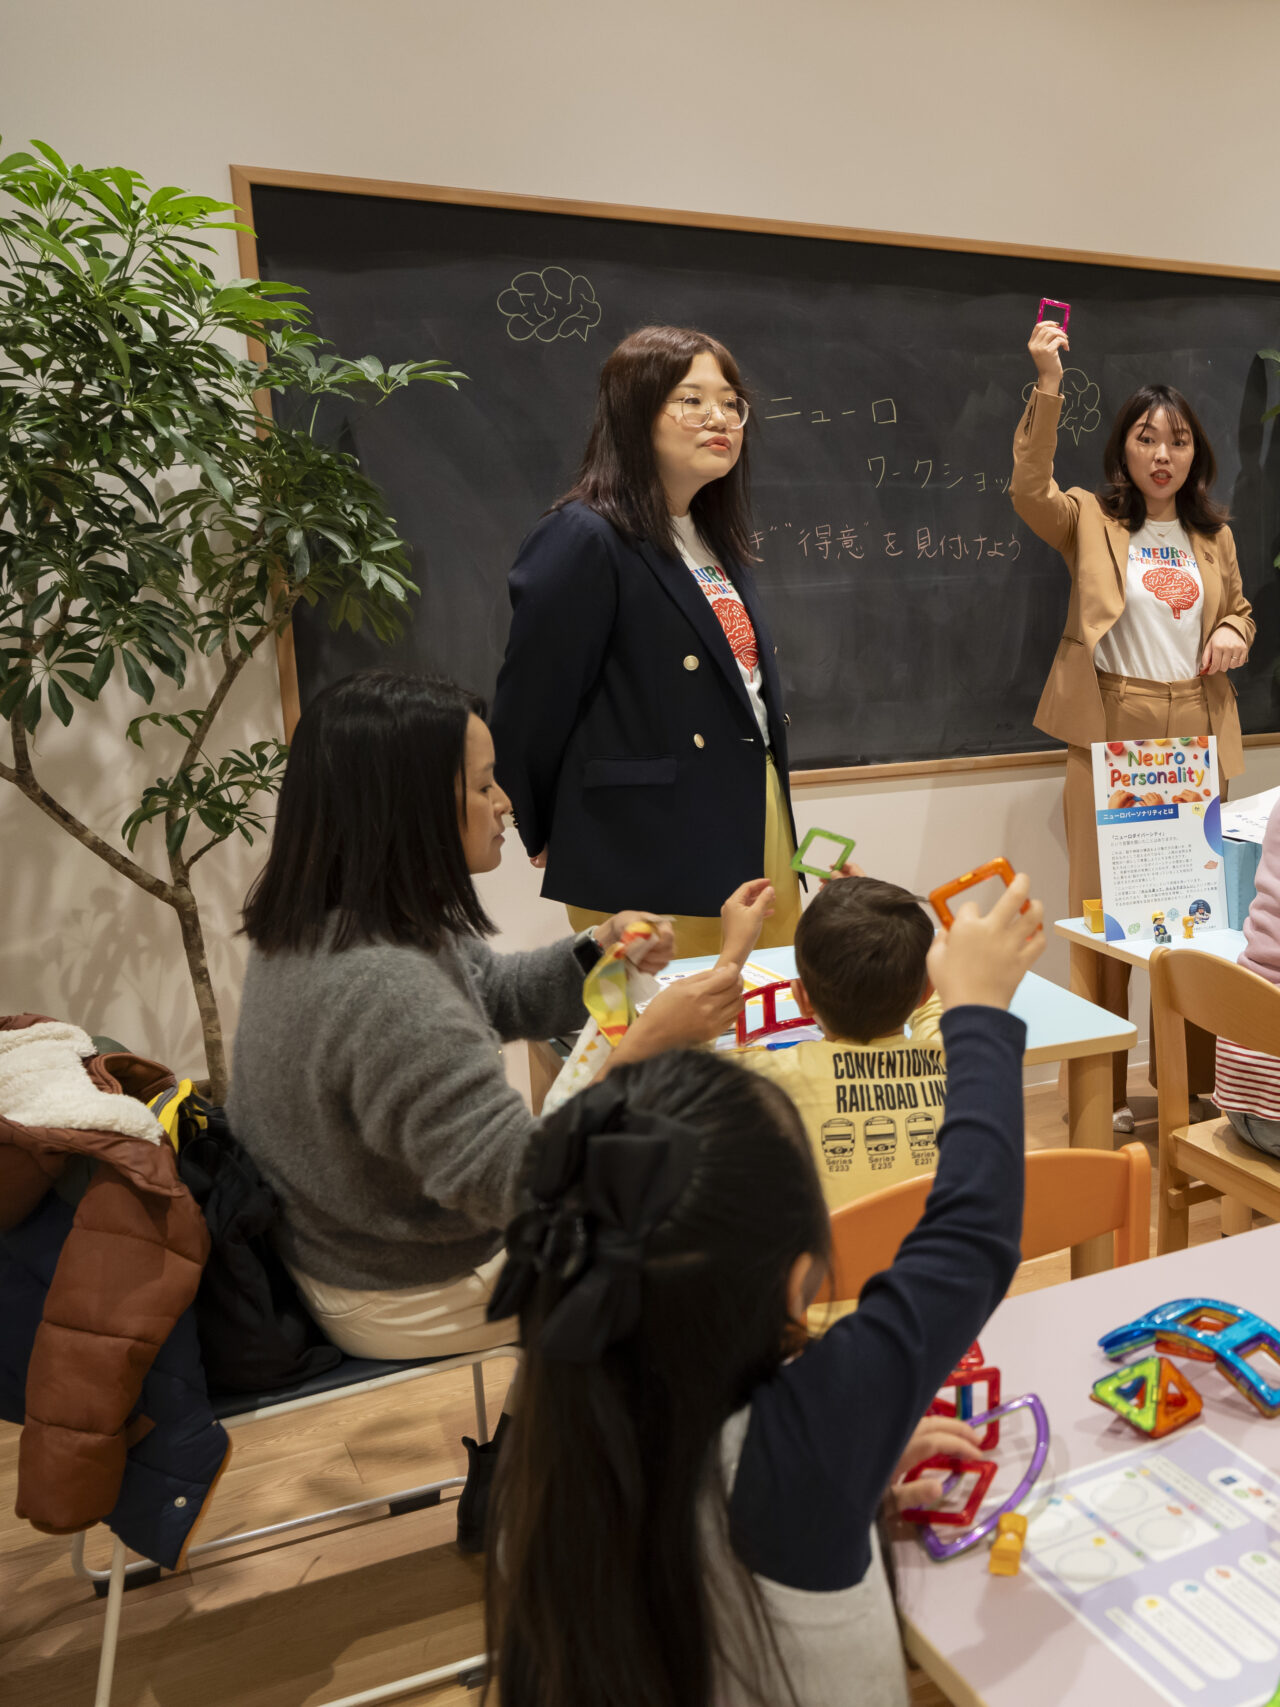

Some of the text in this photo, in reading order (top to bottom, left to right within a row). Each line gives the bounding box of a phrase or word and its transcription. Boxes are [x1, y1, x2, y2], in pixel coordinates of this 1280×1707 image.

[764, 396, 897, 425] ニューロ
[1141, 546, 1188, 560] NEURO
[1127, 749, 1185, 767] Neuro
[1110, 766, 1205, 788] Personality
[1103, 807, 1174, 820] ニューロパーソナリティとは
[833, 1048, 947, 1080] CONVENTIONAL
[836, 1079, 948, 1114] RAILROAD LIN
[826, 1158, 853, 1166] Series
[868, 1155, 895, 1164] Series
[911, 1151, 935, 1159] Series
